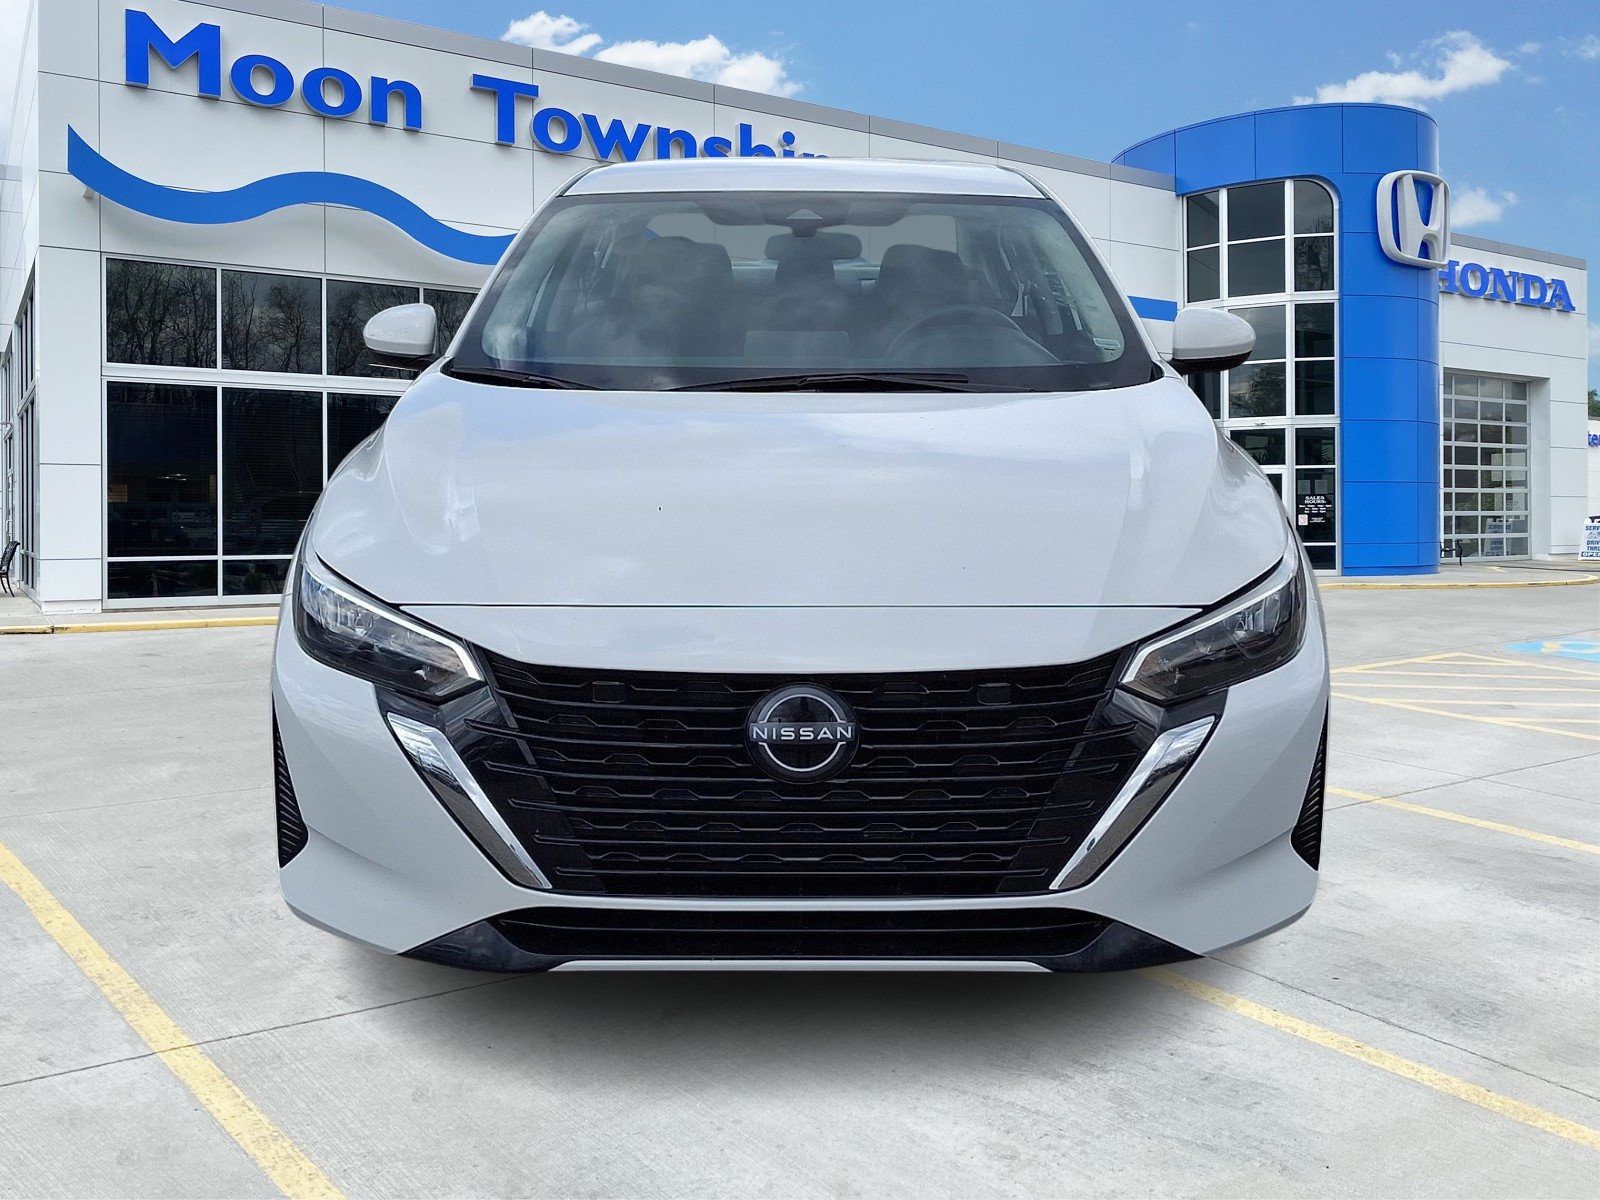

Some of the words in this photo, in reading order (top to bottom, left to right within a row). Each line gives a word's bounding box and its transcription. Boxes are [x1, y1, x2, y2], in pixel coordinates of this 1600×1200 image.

[124, 9, 422, 132] Moon
[469, 73, 831, 164] Townshi
[1438, 259, 1576, 312] HONDA
[752, 726, 852, 740] NISSAN
